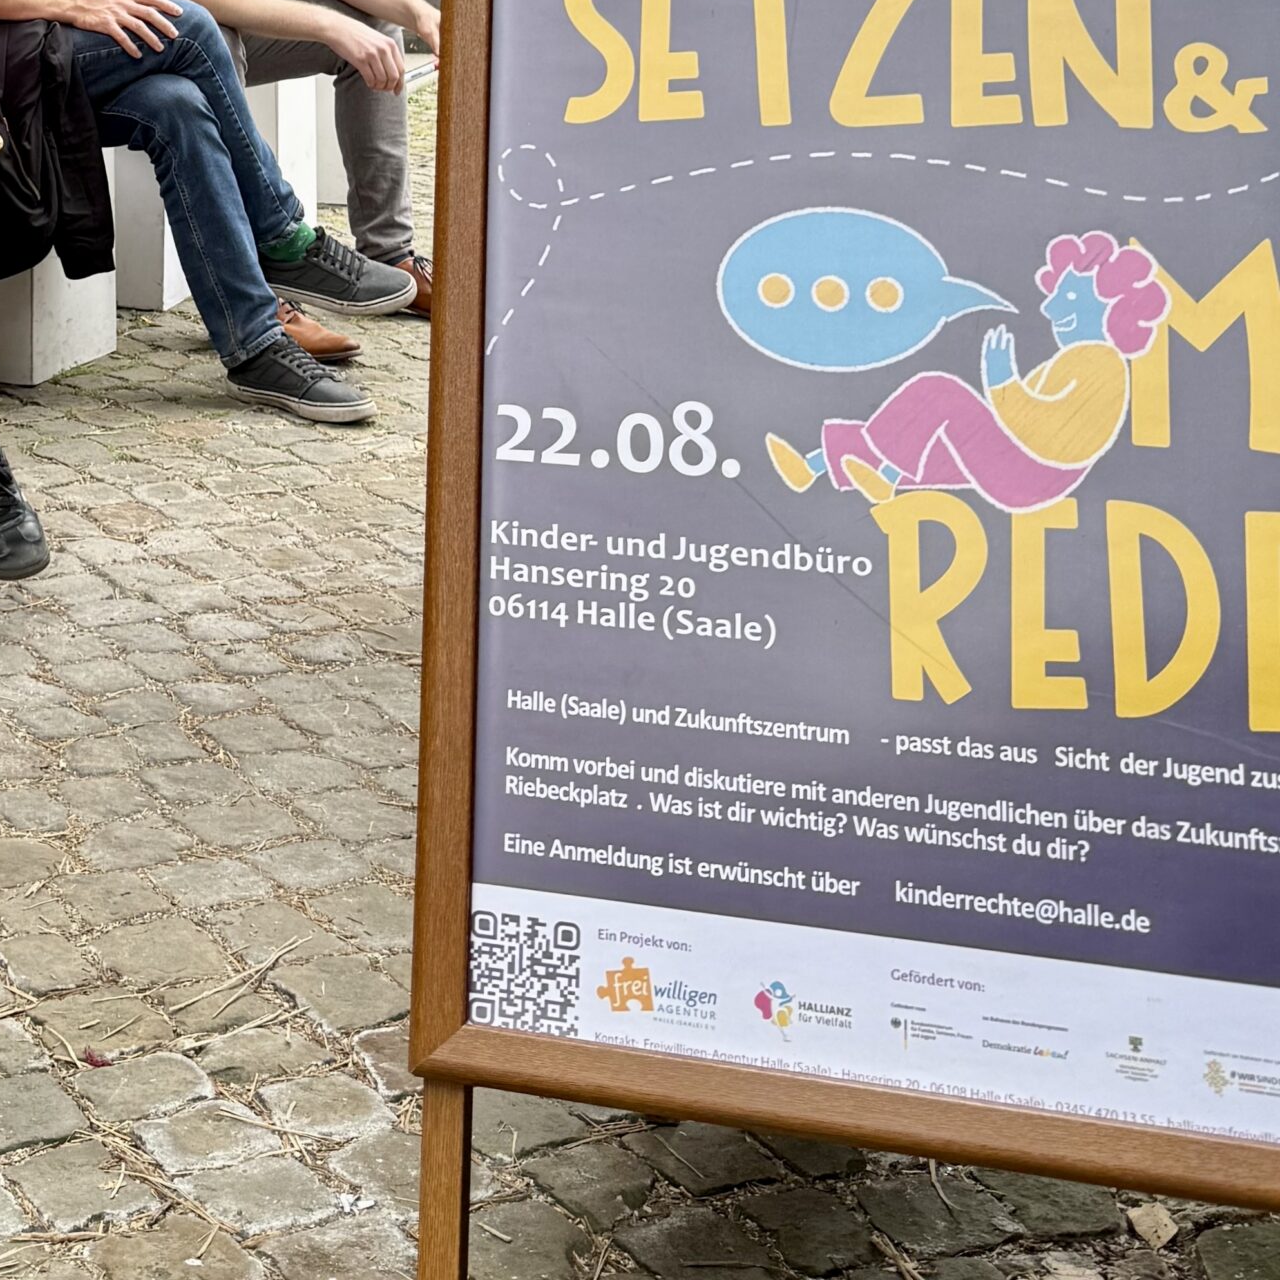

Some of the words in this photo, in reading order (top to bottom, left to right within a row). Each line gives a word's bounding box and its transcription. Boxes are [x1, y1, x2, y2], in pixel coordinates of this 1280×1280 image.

[495, 400, 741, 479] 22.08.
[491, 520, 598, 552] Kinder-
[606, 533, 666, 559] und
[672, 536, 873, 577] Jugendbüro
[490, 556, 650, 602] Hansering
[659, 577, 696, 599] 20
[488, 594, 568, 628] 06114
[577, 600, 655, 631] Halle
[662, 605, 776, 649] (Saale)
[507, 689, 556, 713] Halle
[561, 693, 626, 725] (Saale)
[632, 705, 670, 726] und
[675, 707, 849, 744] Zukunftszentrum
[895, 734, 951, 755] passt
[956, 736, 994, 760] das
[999, 745, 1037, 764] aus
[1055, 746, 1110, 771] Sicht
[1120, 752, 1158, 776] der
[1163, 757, 1244, 786] Jugend
[1250, 771, 1280, 789] zu
[505, 775, 628, 808] Riebeckplatz
[649, 792, 692, 816] Was
[698, 797, 722, 820] ist
[727, 802, 756, 823] dir
[760, 807, 847, 837] wichtig?
[853, 816, 899, 840] Was
[904, 823, 1007, 853] wünschst
[1012, 834, 1040, 857] du
[1046, 838, 1090, 862] dir?
[506, 746, 568, 772] Komm
[573, 757, 635, 781] vorbei
[641, 765, 679, 785] und
[684, 766, 786, 797] diskutiere
[791, 781, 826, 802] mit
[832, 786, 919, 812] anderen
[924, 793, 1067, 829] Jugendlichen
[1074, 809, 1126, 835] über
[1132, 815, 1171, 841] das
[1176, 821, 1280, 853] Zukunfts
[504, 832, 545, 856] Eine
[549, 838, 663, 876] Anmeldung
[668, 853, 692, 875] ist
[697, 861, 806, 890] erwünscht
[811, 871, 860, 896] über
[895, 880, 1151, 933] kinderrechte@halle.de
[598, 928, 617, 942] Ein
[619, 931, 664, 948] Projekt
[666, 940, 692, 952] von:
[890, 968, 955, 990] Gefördert
[957, 978, 986, 993] von:
[657, 1004, 717, 1021] AGENTUR
[798, 1001, 852, 1017] HALLIANZ
[798, 1012, 812, 1023] für
[815, 1015, 852, 1029] Vielfalt
